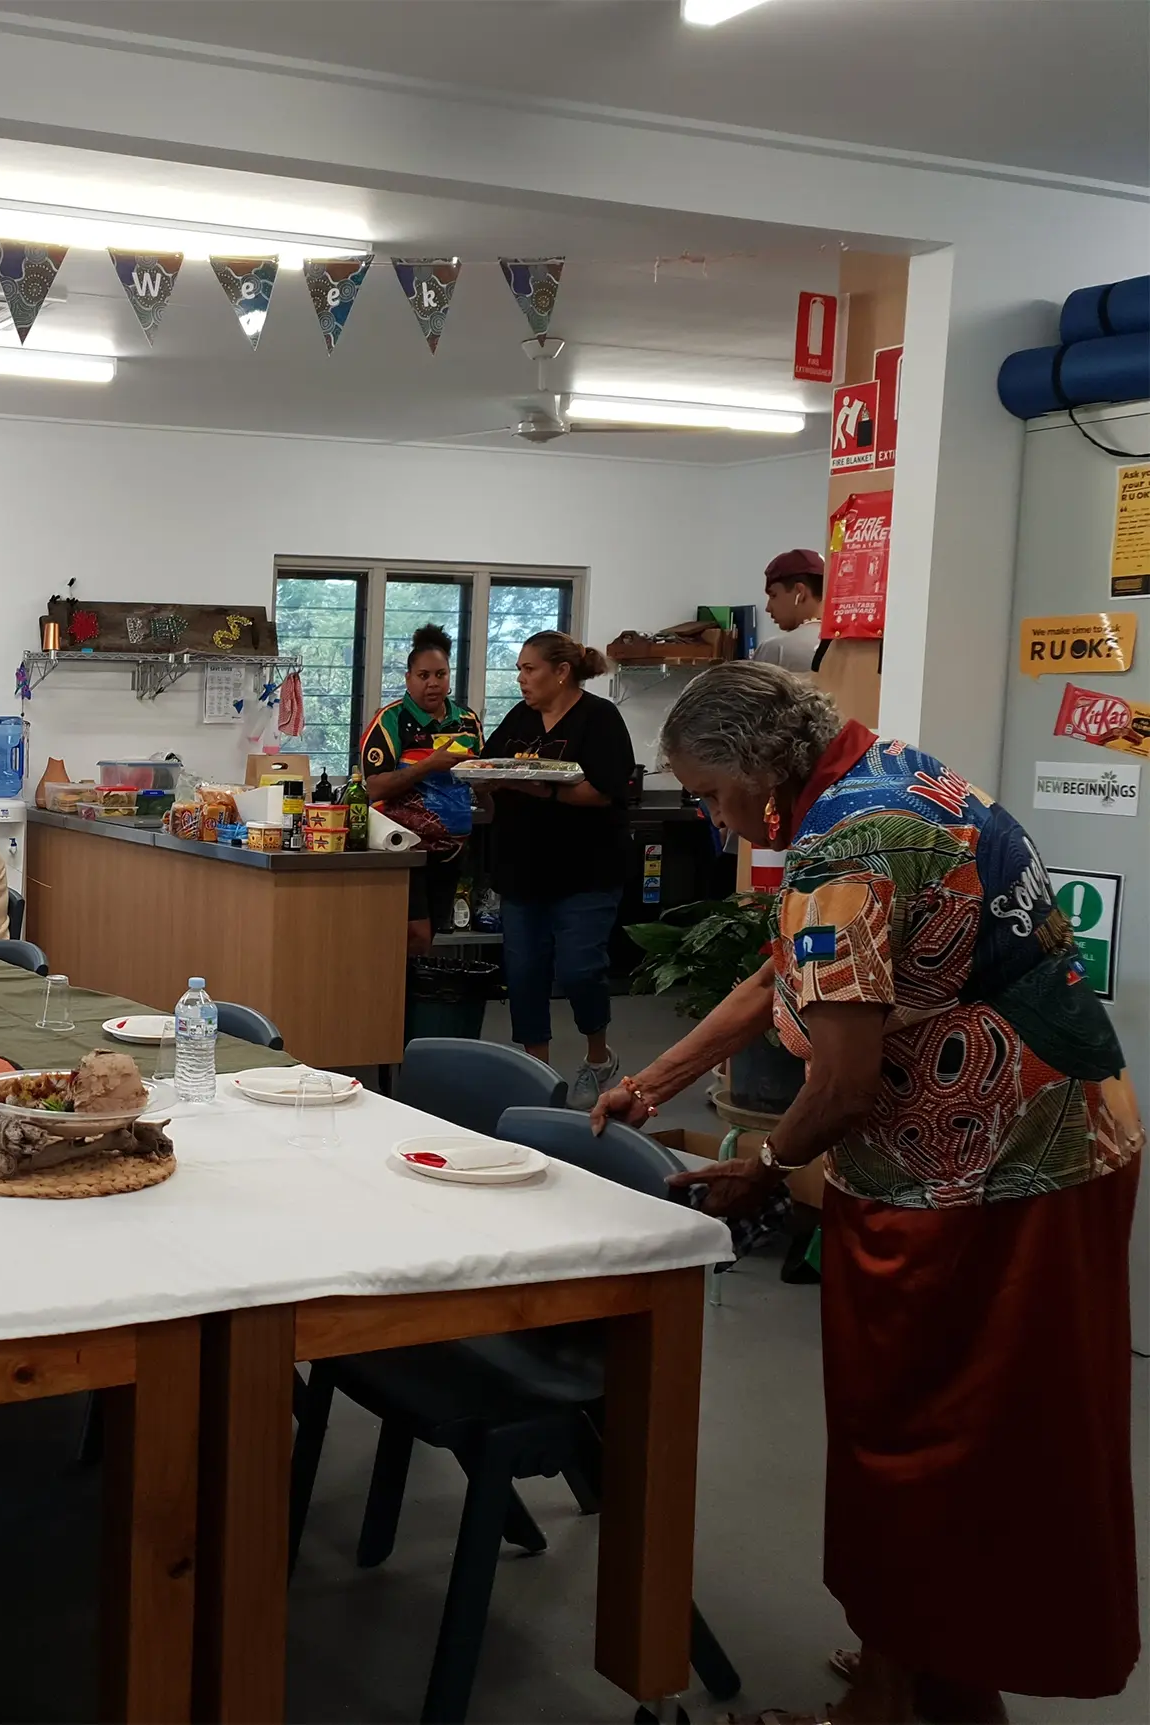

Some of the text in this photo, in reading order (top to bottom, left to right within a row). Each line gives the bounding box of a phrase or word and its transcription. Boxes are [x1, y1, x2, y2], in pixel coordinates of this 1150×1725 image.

[846, 454, 873, 465] BLANKET
[1123, 471, 1139, 480] Ask
[1122, 481, 1145, 493] your
[853, 516, 886, 530] FIRE
[1047, 627, 1070, 636] make
[1072, 626, 1092, 634] time
